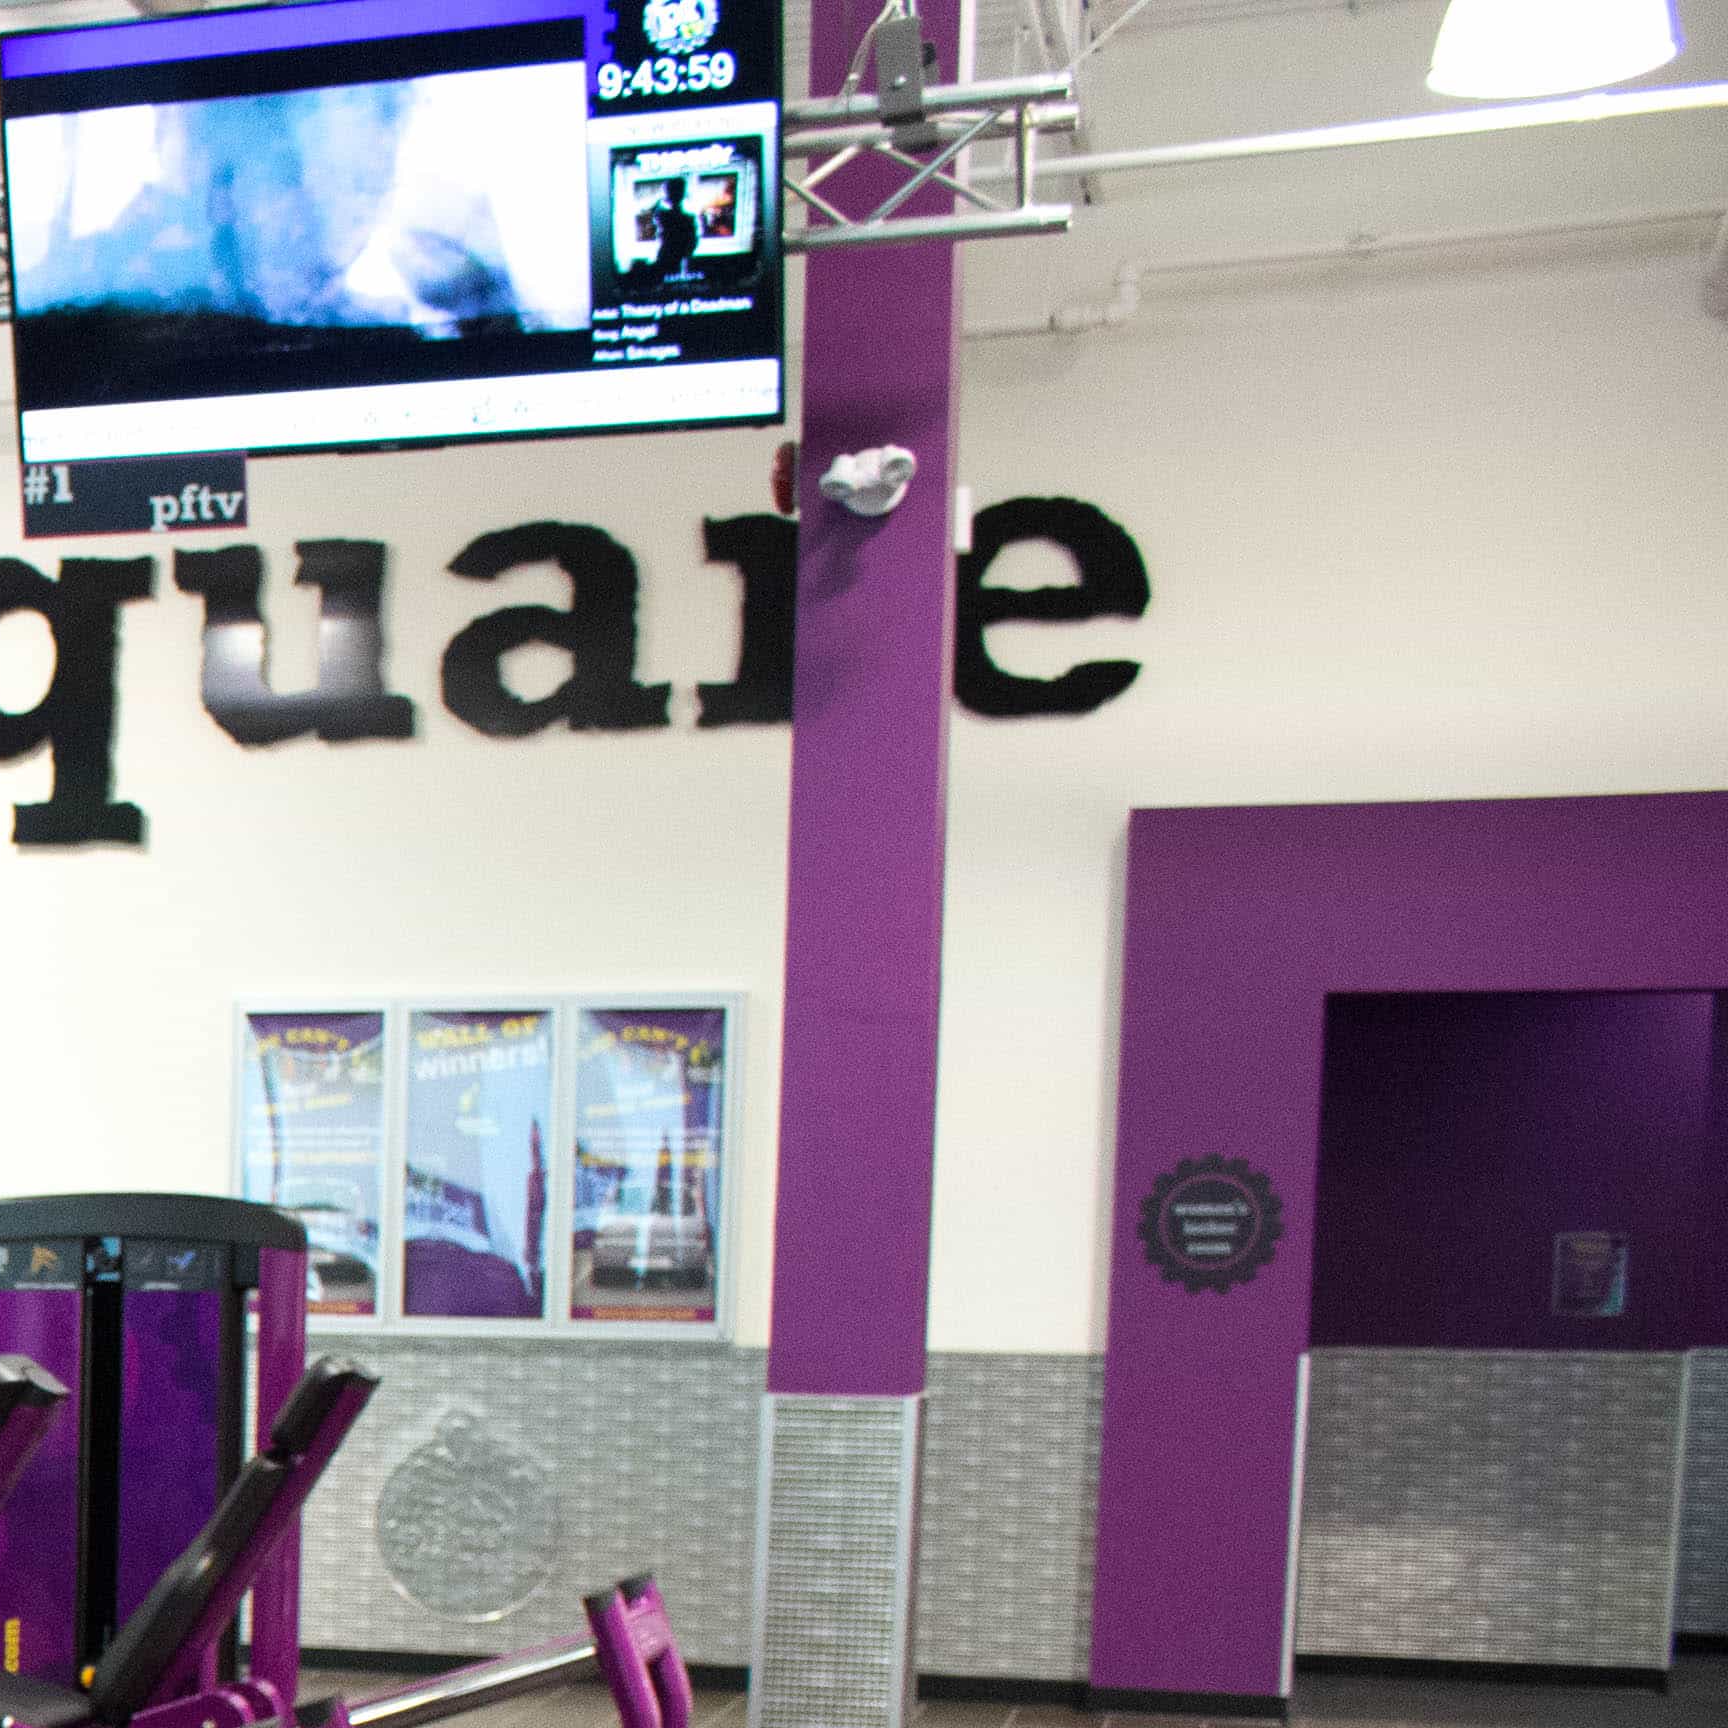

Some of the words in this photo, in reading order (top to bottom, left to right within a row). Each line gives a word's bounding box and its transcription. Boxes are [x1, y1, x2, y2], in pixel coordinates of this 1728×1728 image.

[598, 52, 735, 100] 9:43:59
[23, 465, 73, 504] #1
[149, 484, 244, 533] pftv
